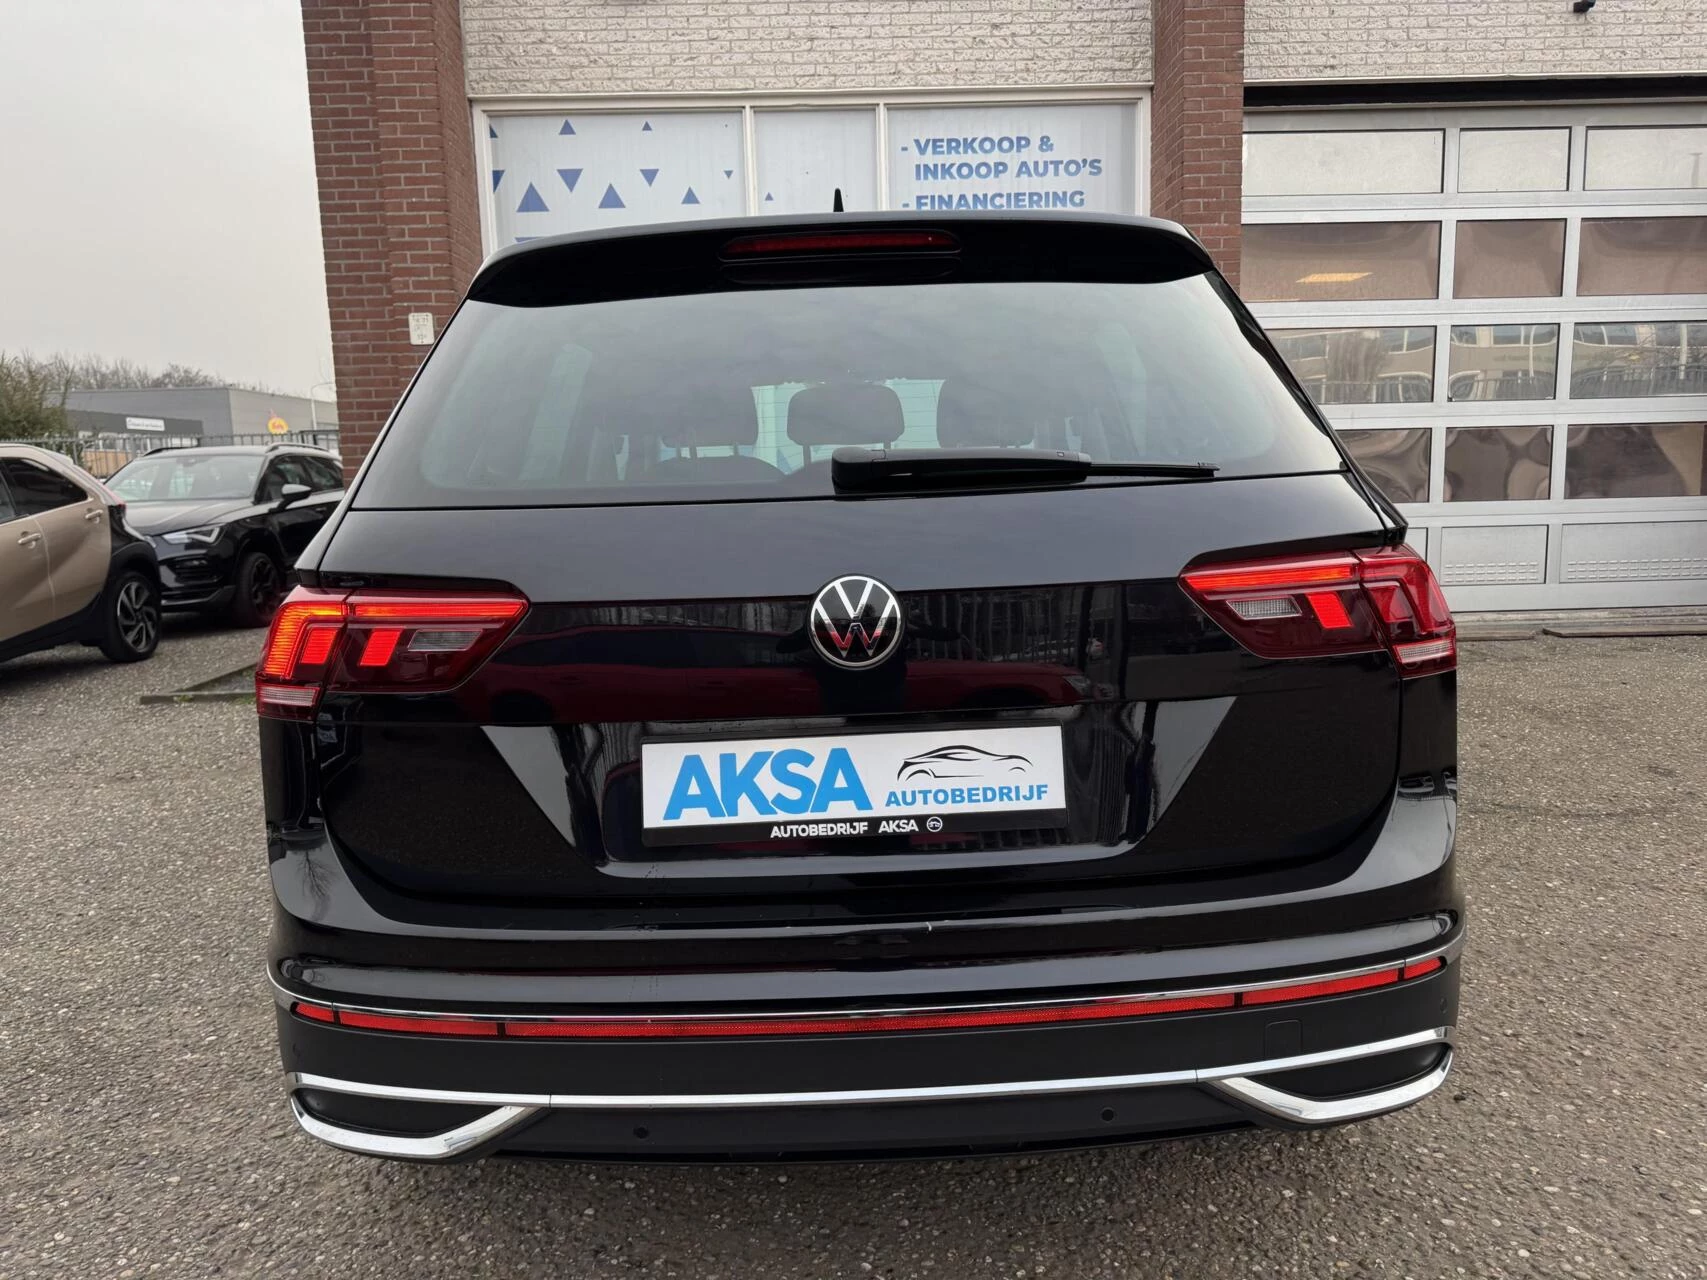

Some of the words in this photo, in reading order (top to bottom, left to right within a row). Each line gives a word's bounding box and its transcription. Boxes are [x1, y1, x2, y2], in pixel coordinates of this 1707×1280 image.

[913, 136, 1031, 155] VERKOOP
[1038, 135, 1054, 152] &
[915, 161, 1008, 181] INKOOP
[1016, 158, 1103, 178] AUTO’S
[915, 190, 1085, 210] FINANCIERING
[663, 747, 874, 821] AKSA
[885, 784, 1048, 807] AUTOBEDRIJF
[770, 822, 868, 839] AUTOBEDRIJF
[878, 819, 919, 834] AKSA
